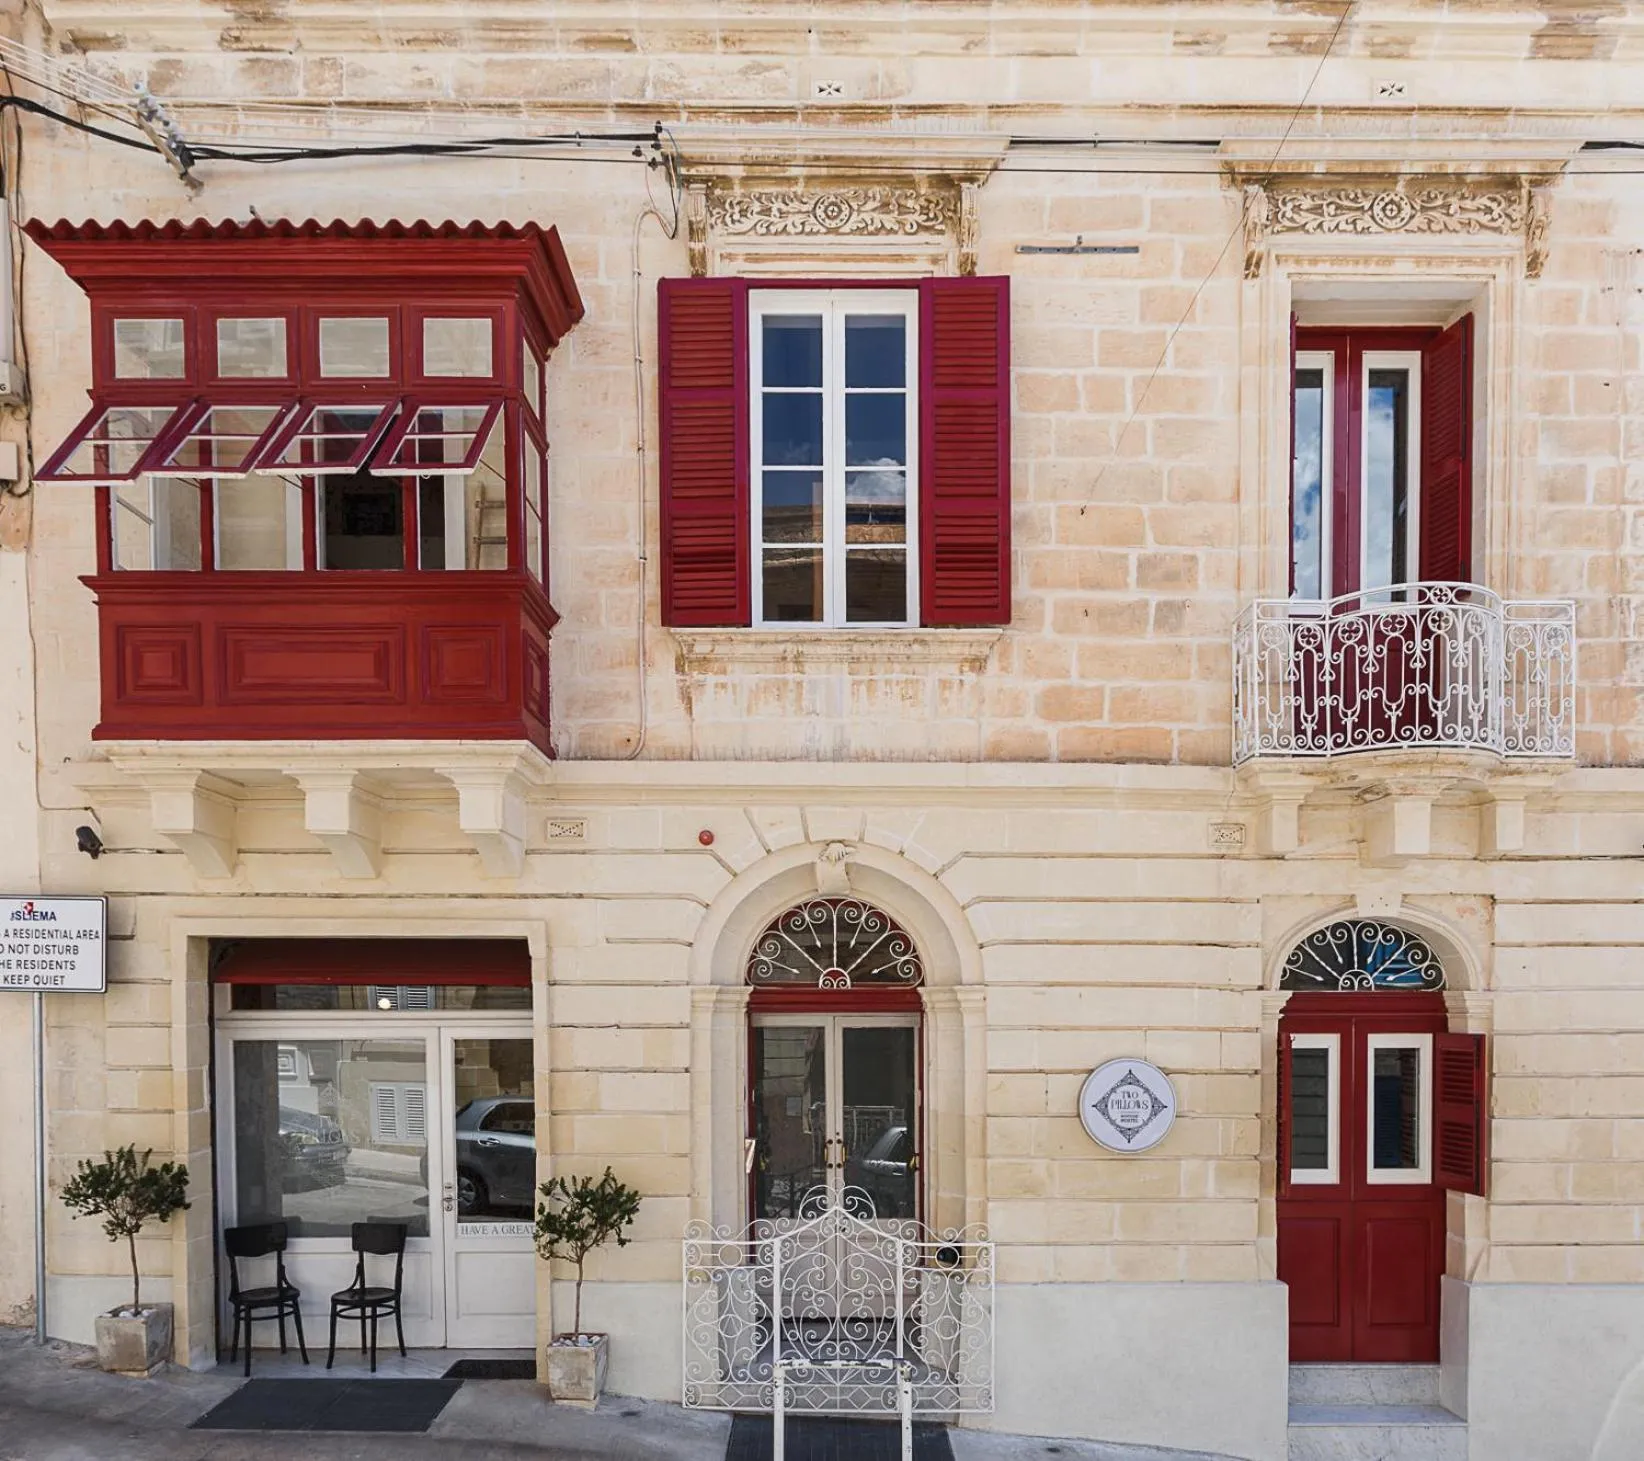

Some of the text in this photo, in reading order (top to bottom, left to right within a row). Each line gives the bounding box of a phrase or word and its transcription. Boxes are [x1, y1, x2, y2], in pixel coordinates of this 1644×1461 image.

[4, 928, 10, 938] A
[13, 928, 74, 940] RESIDENTIAL
[76, 929, 100, 940] AREA
[8, 943, 30, 954] NOT
[33, 944, 79, 955] DISTURB
[0, 959, 76, 970] HE RESIDENTS
[3, 974, 65, 986] KEEP QUIET
[1121, 1091, 1139, 1099] TWO
[1111, 1099, 1149, 1110] PILLOWS
[461, 1224, 535, 1235] HAVE A GREAT
